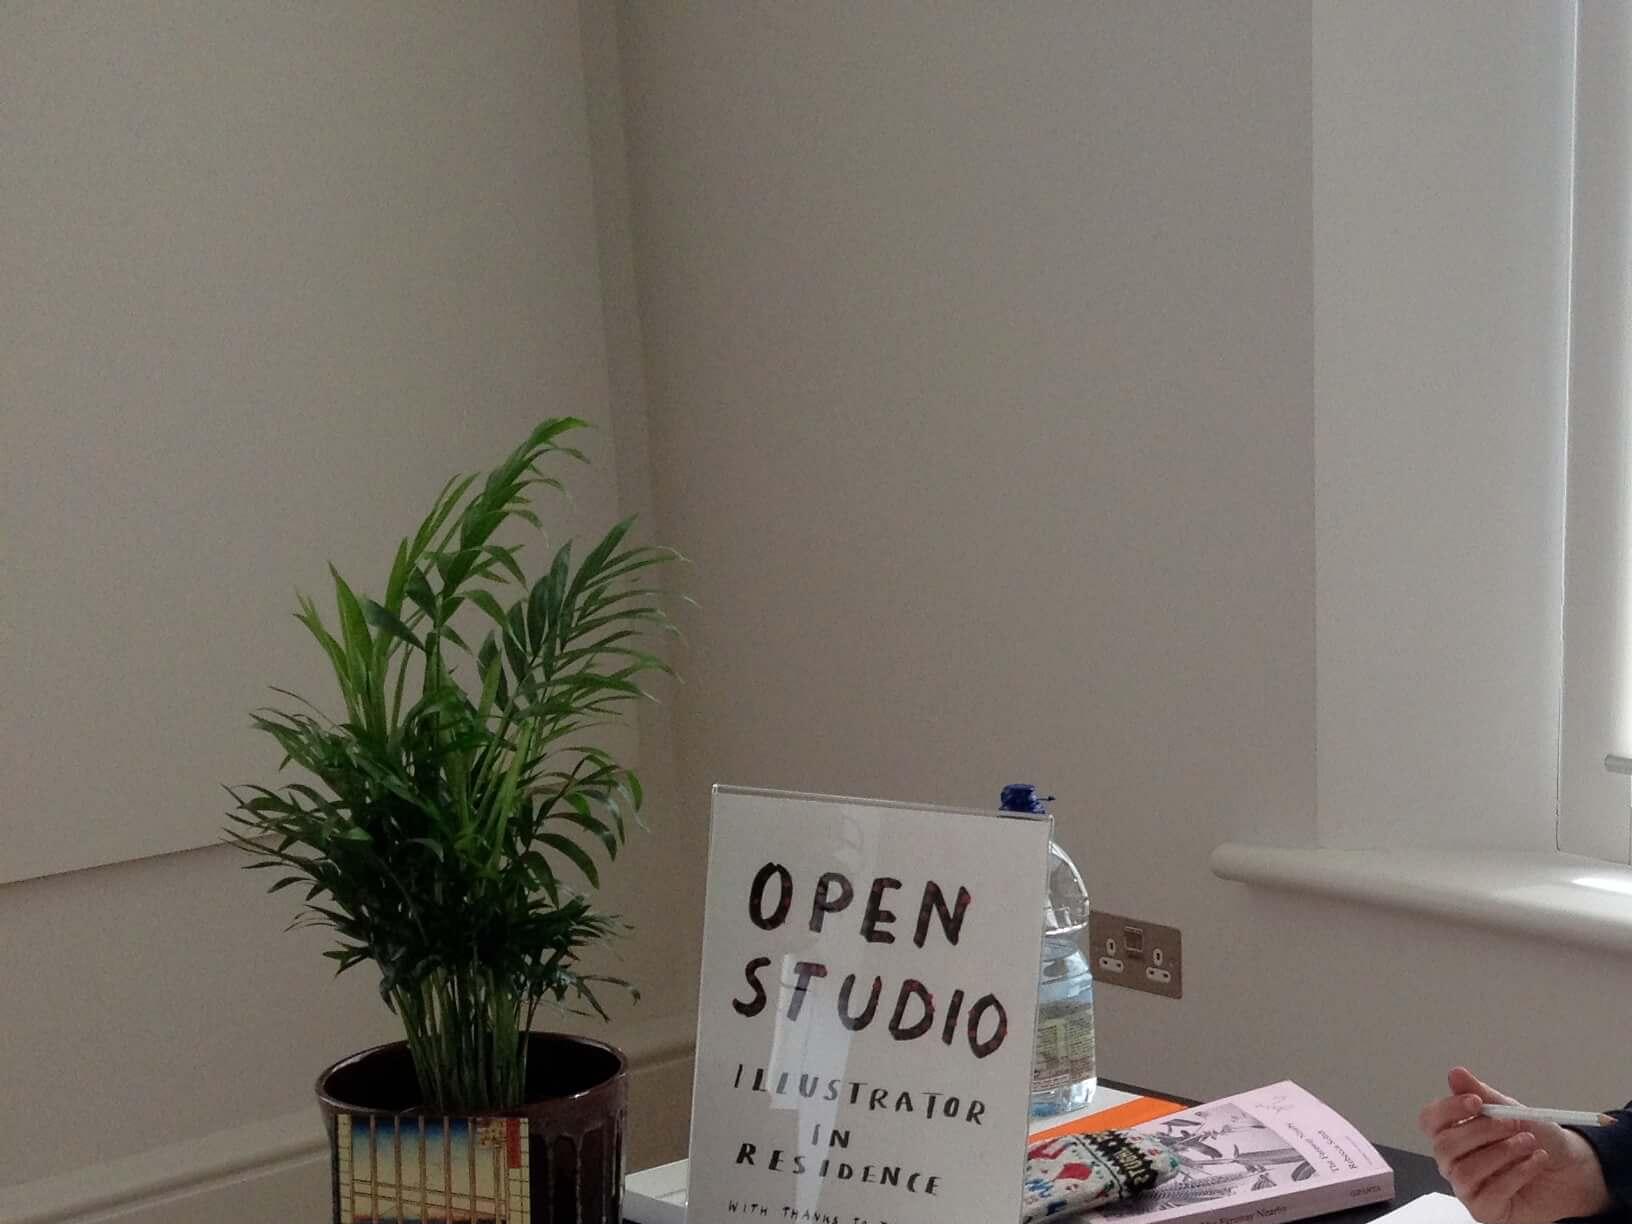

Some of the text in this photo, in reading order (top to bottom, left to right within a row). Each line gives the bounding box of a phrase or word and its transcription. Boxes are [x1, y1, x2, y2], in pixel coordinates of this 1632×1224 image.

[748, 861, 971, 948] OPEN
[732, 957, 1009, 1060] STUDIO
[733, 1063, 987, 1126] ILLUSTRATOR
[811, 1123, 850, 1149] IN
[736, 1142, 943, 1197] RESIDENCE
[728, 1200, 768, 1216] WITH
